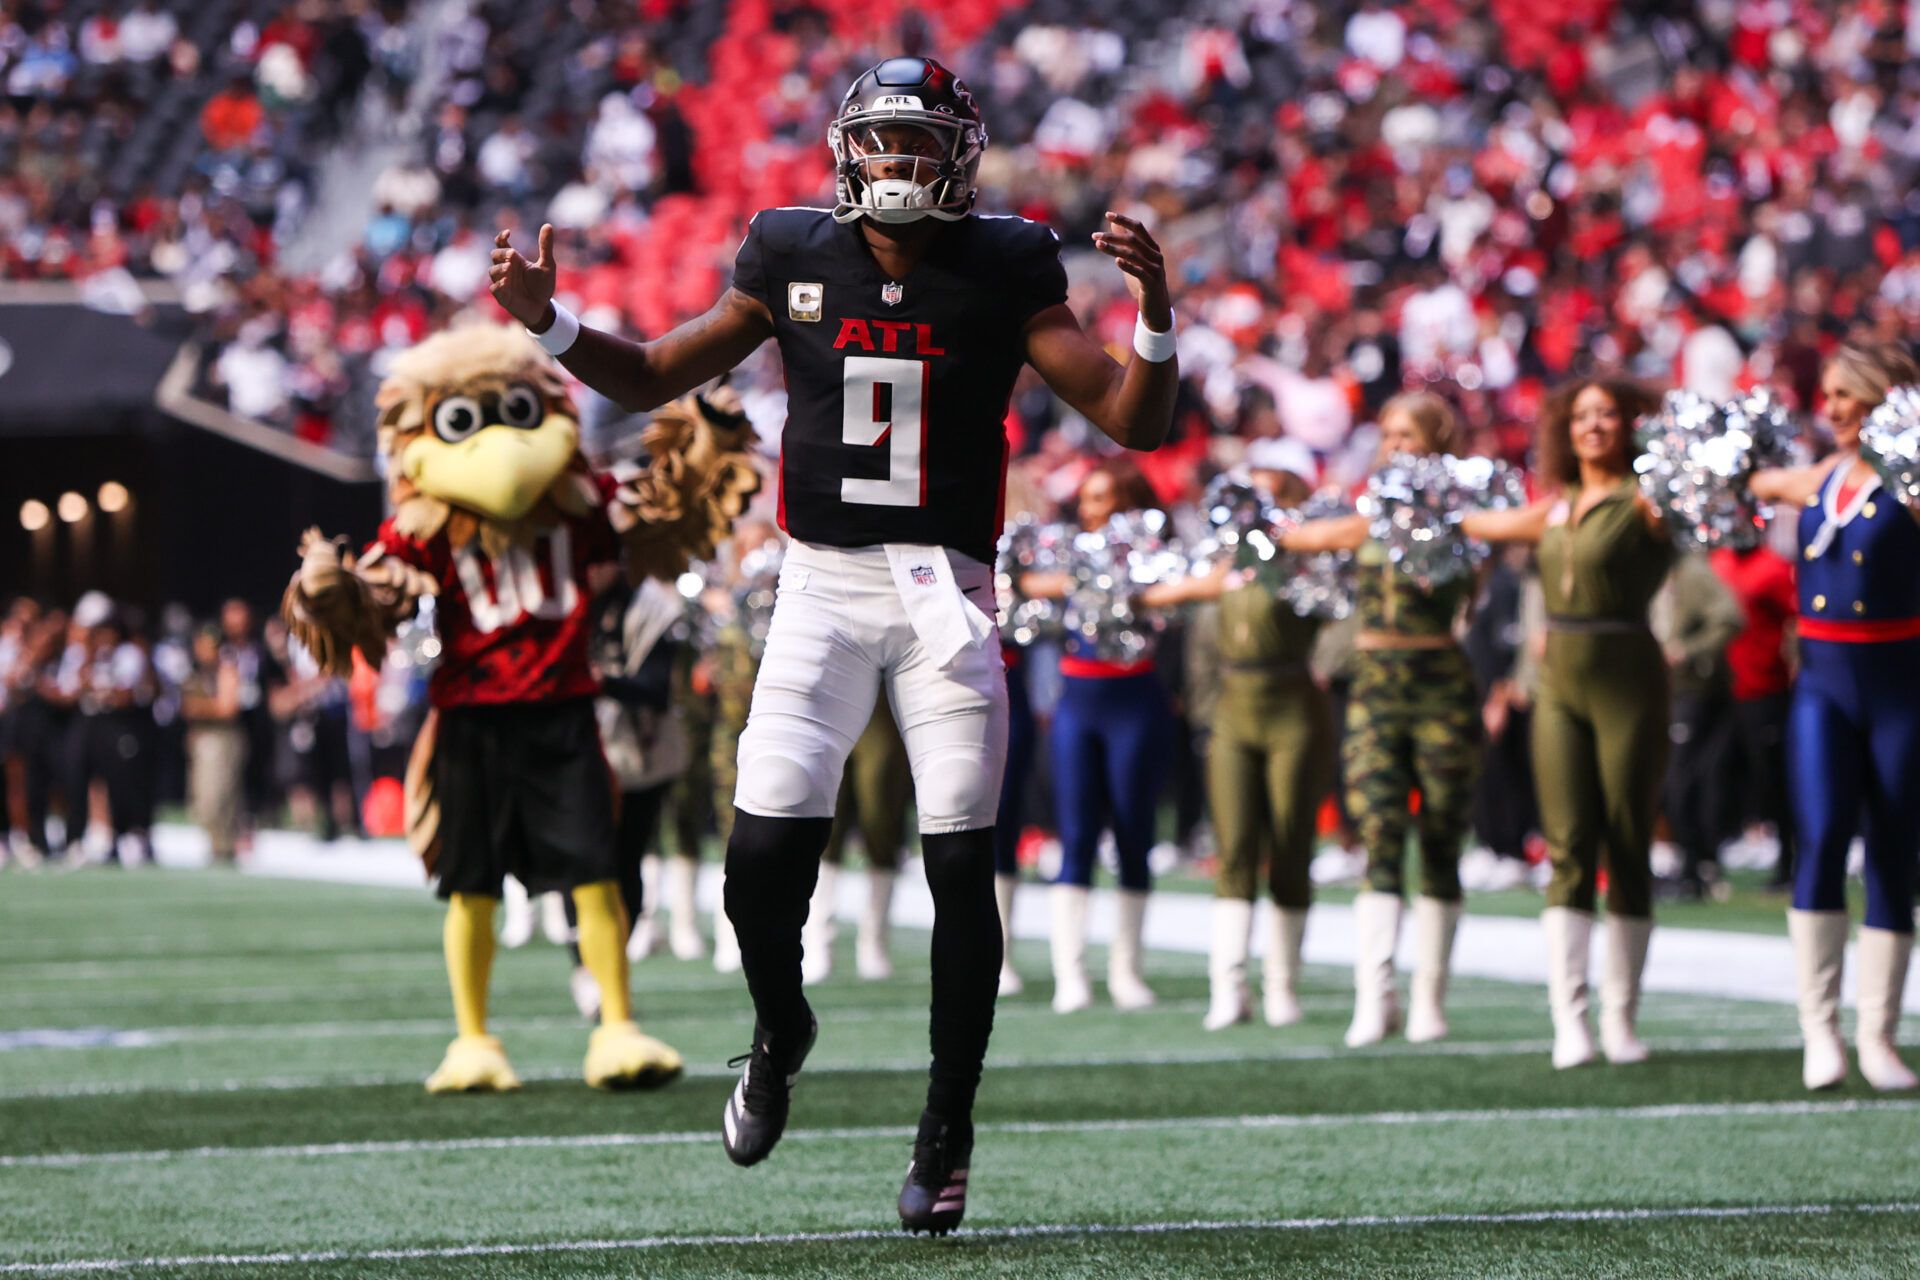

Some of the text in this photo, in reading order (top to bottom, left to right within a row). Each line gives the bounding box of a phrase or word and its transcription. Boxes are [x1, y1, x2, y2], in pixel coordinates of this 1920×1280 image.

[884, 96, 910, 104] ATL
[791, 285, 820, 311] C
[833, 317, 945, 356] ATL
[841, 356, 930, 507] 9
[915, 575, 935, 585] NFL
